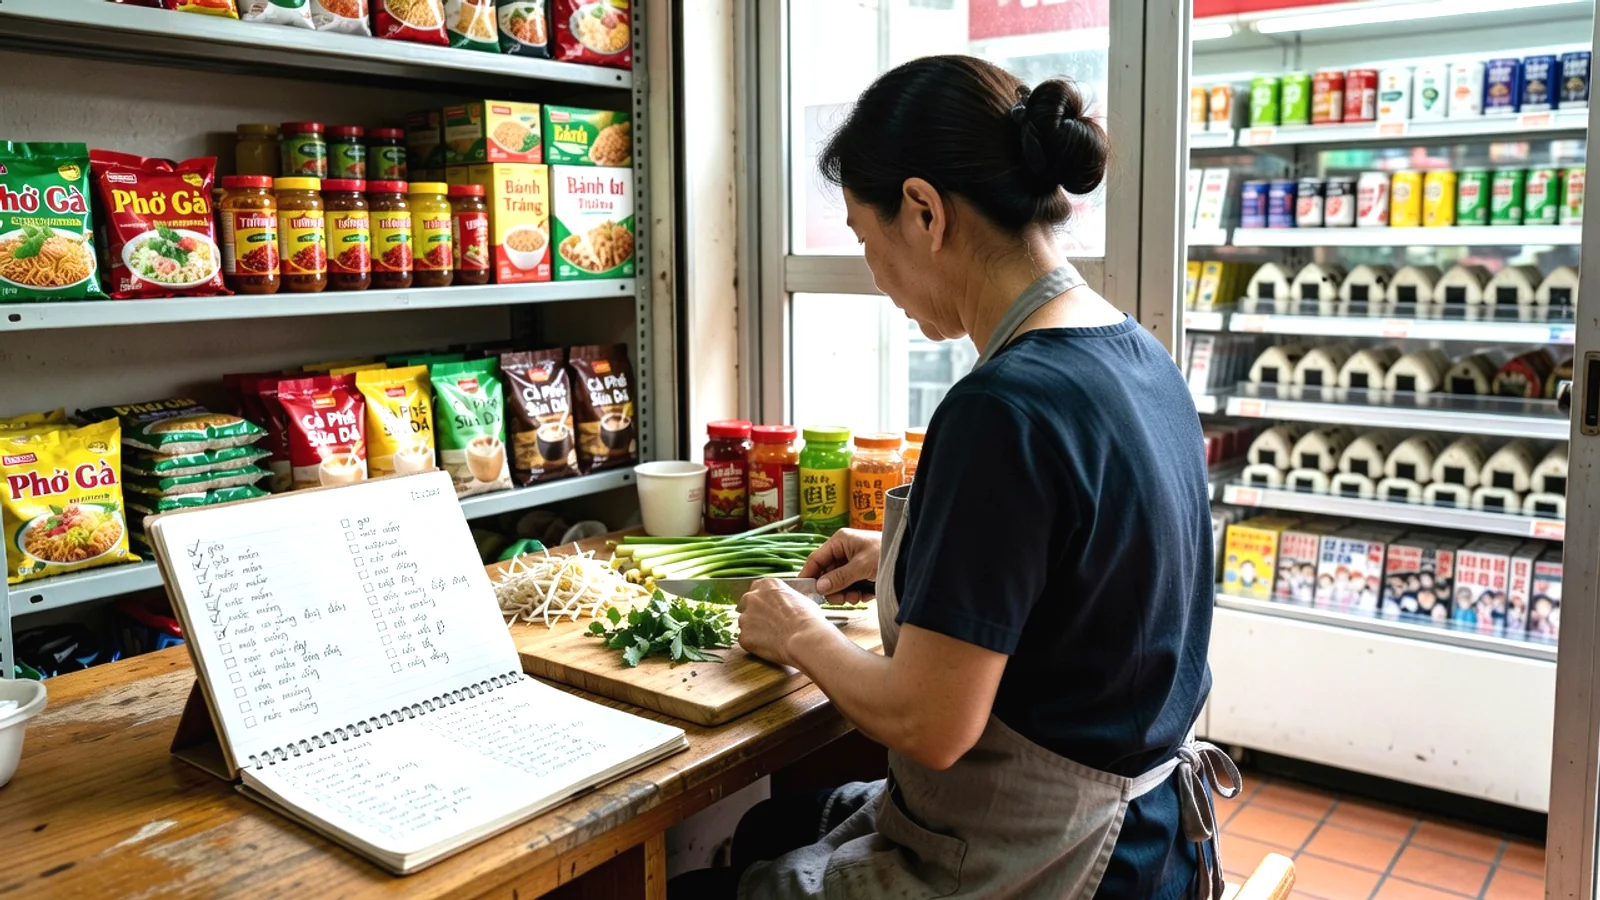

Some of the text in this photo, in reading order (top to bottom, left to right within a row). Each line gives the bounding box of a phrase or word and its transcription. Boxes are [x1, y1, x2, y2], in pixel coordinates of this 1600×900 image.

[505, 179, 540, 194] Bánh
[46, 186, 88, 213] Gà
[171, 190, 208, 215] Gà
[503, 197, 543, 217] Tráng
[75, 459, 117, 489] Gà
